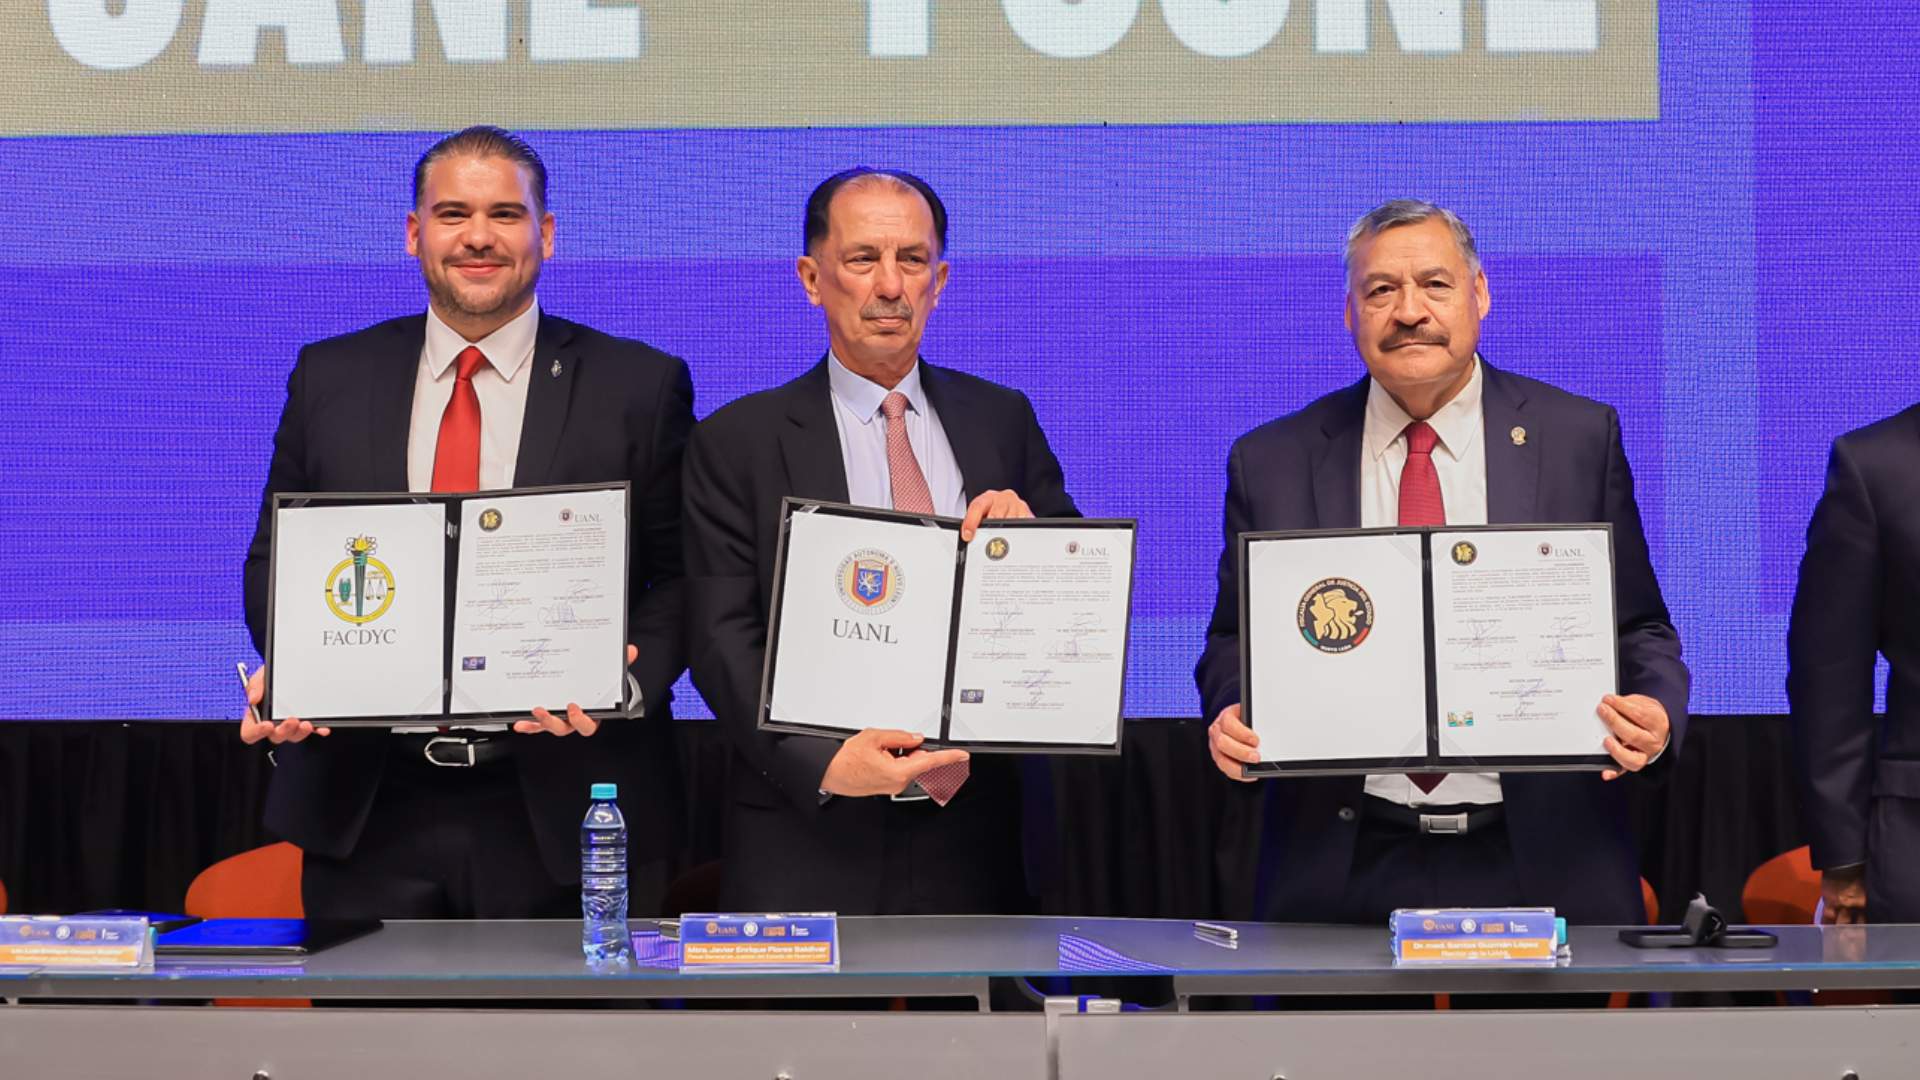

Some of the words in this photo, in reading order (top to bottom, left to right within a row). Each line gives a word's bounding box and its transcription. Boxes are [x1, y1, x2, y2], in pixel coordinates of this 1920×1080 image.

[574, 512, 603, 523] UANL
[1081, 546, 1110, 556] UANL
[1554, 547, 1585, 558] UANL
[322, 628, 397, 646] FACDYC
[833, 619, 898, 644] UANL
[735, 946, 767, 955] Enrique
